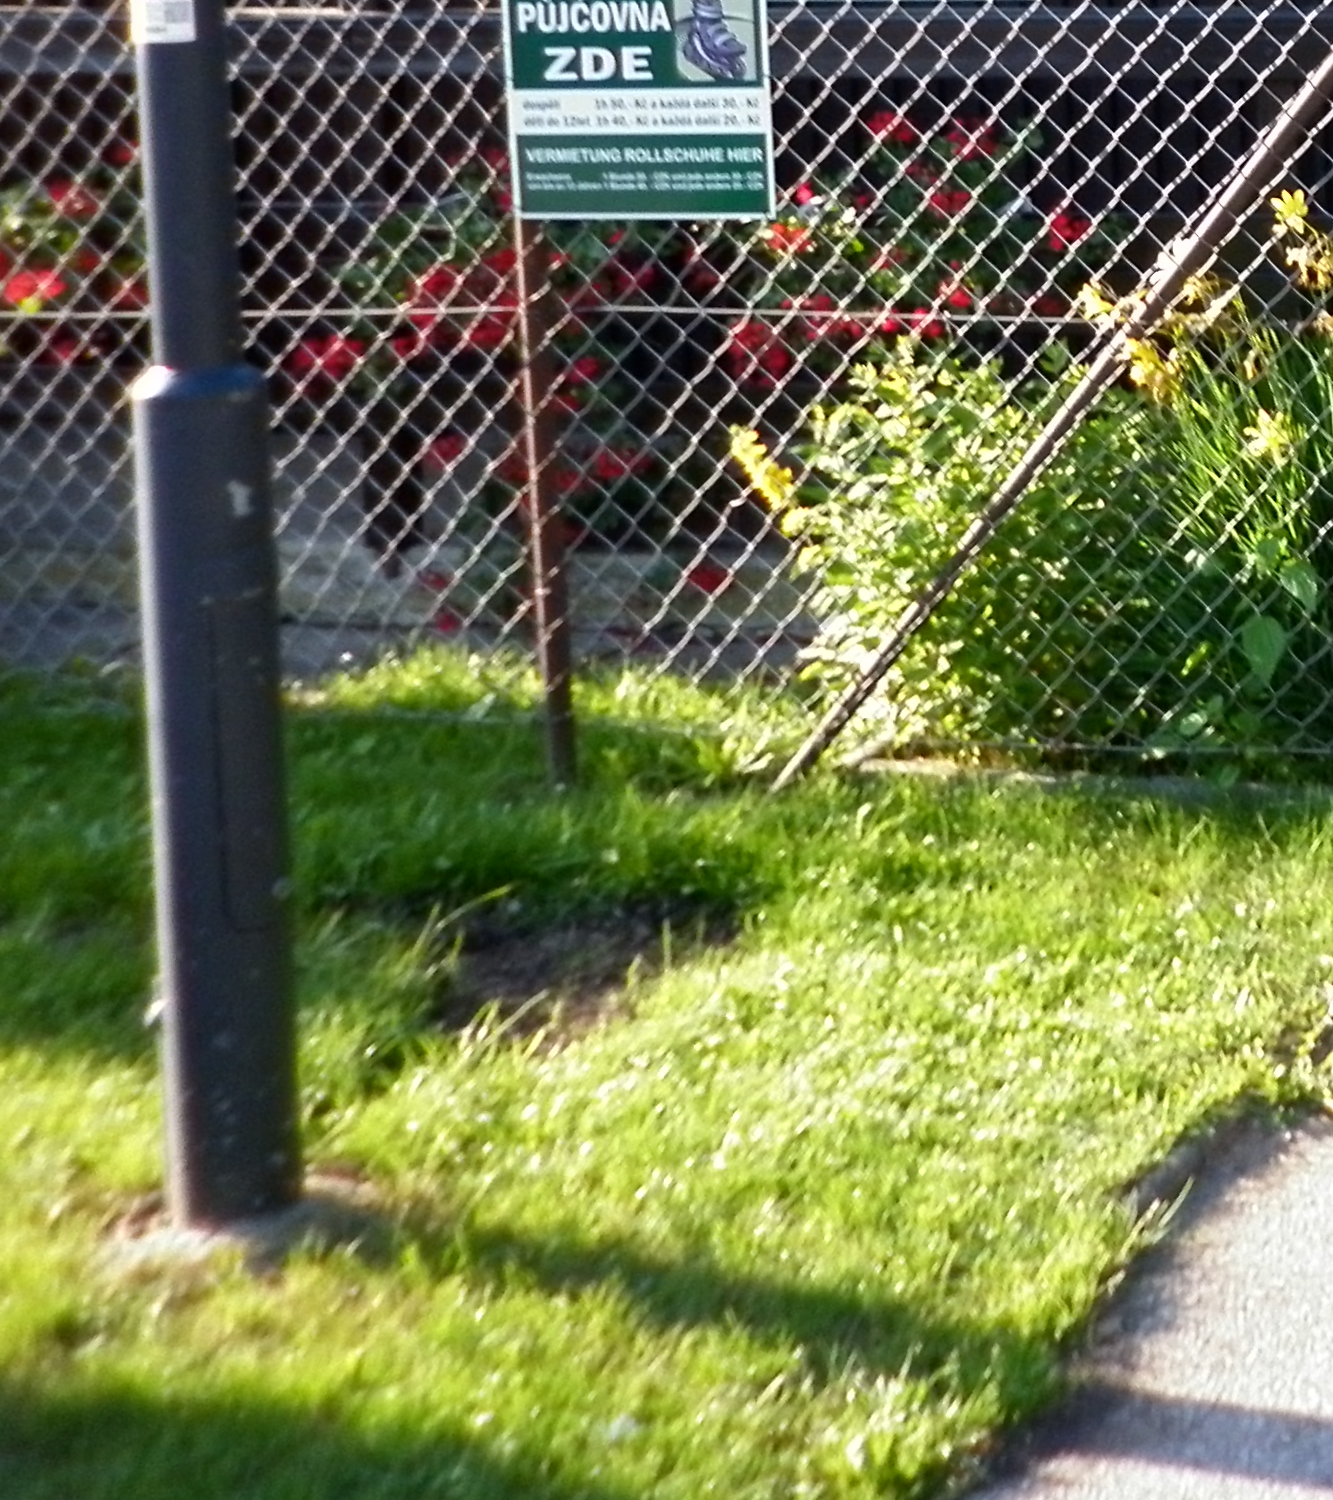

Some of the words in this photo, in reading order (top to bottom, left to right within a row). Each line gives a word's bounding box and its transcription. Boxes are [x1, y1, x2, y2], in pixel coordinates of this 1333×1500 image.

[543, 46, 654, 82] ZDE
[524, 147, 622, 164] VERMIETUNG
[623, 146, 725, 163] ROLLSCHUHE
[726, 146, 764, 163] HIER
